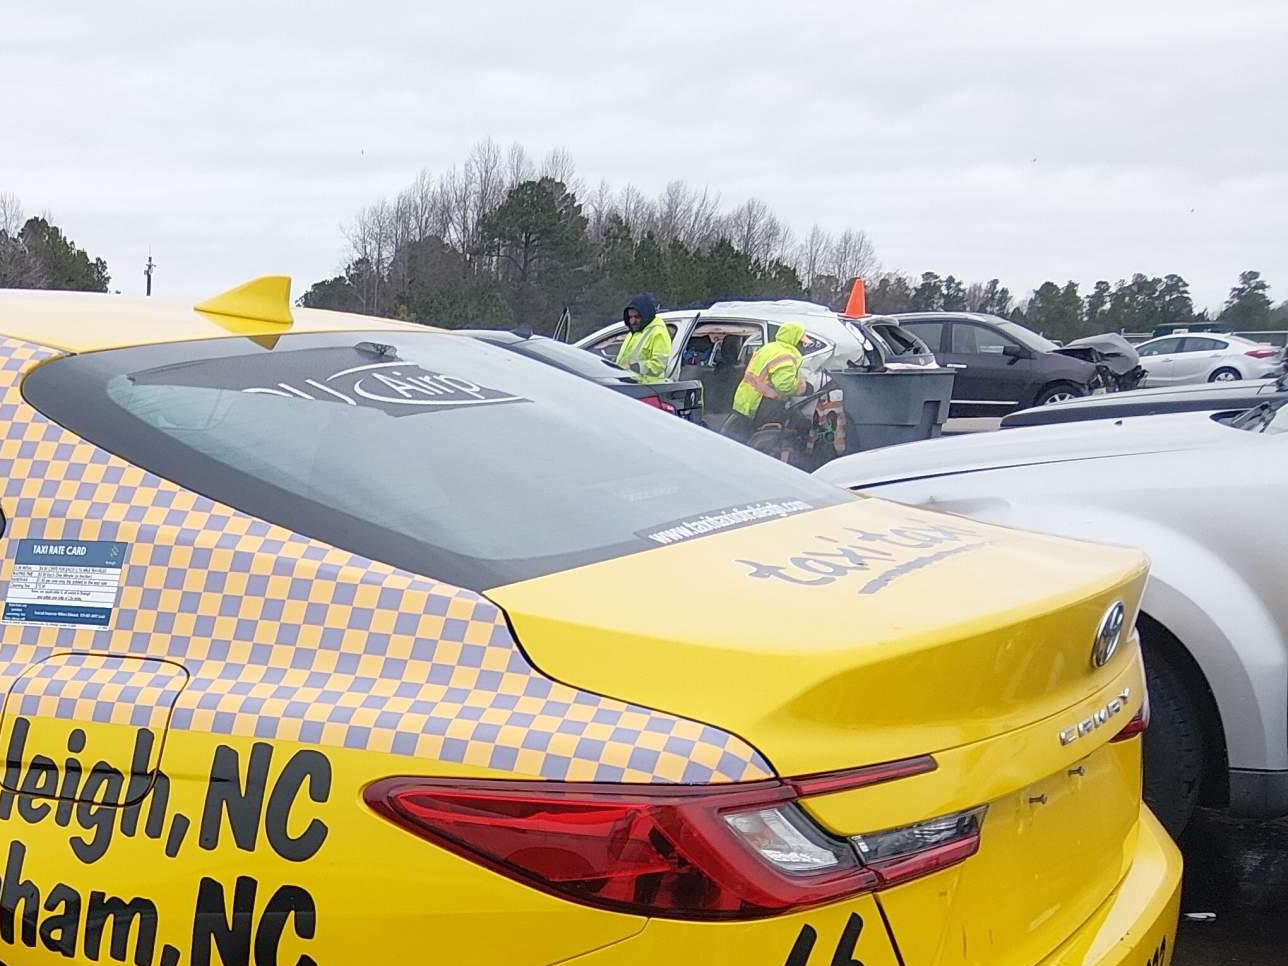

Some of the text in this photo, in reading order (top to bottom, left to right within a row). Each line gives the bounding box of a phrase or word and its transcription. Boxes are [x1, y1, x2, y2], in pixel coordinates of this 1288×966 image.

[32, 544, 87, 556] TAXI RATE CARD
[735, 536, 896, 586] taxi
[198, 742, 332, 862] NC
